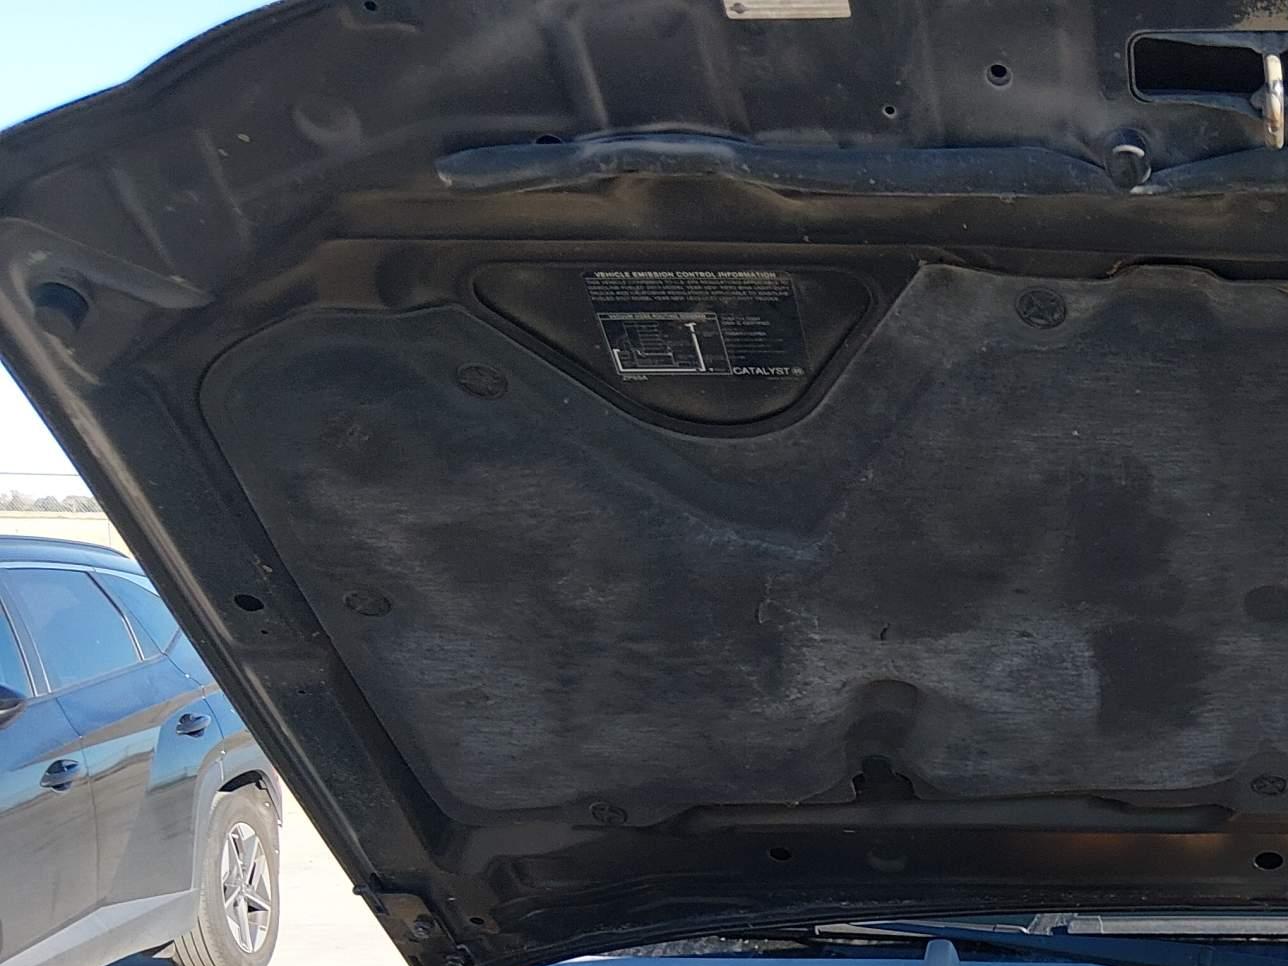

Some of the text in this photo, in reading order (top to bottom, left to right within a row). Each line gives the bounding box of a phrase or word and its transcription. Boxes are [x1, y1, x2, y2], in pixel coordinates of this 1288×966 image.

[675, 271, 717, 279] CONTROL
[718, 271, 777, 279] INFORMATION
[732, 366, 791, 375] CATALYST
